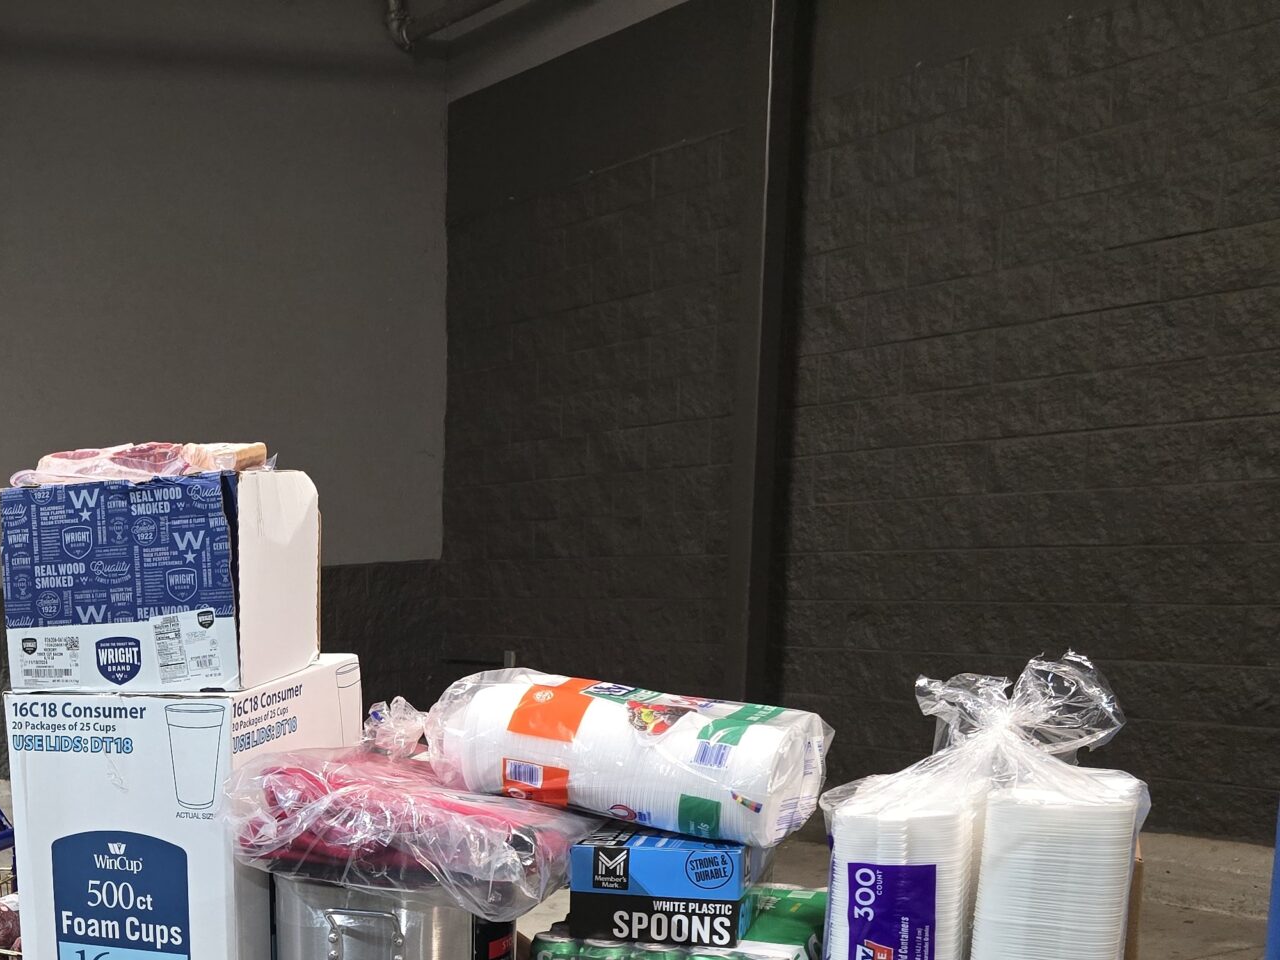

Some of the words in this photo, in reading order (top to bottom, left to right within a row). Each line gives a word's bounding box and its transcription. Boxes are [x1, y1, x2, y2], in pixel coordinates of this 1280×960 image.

[69, 488, 99, 508] W
[130, 491, 153, 503] REAL
[154, 487, 182, 500] WOOD
[131, 502, 170, 516] SMOKED
[65, 531, 89, 544] WRIGHT
[137, 532, 153, 540] 1922
[34, 565, 57, 577] REAL
[58, 562, 85, 575] WOOD
[90, 560, 131, 576] Quality
[36, 576, 73, 589] SMOKED
[168, 574, 194, 586] WRIGHT
[110, 593, 132, 602] WRIGHT
[98, 647, 139, 666] WRIGHT
[233, 696, 258, 718] 16C18
[260, 683, 302, 709] Consumer
[12, 702, 58, 718] 16C18
[62, 702, 146, 719] Consumer
[240, 715, 262, 730] Packages
[270, 710, 276, 719] 25
[277, 706, 288, 716] Cups
[12, 721, 22, 730] 20
[25, 721, 66, 732] Packages
[68, 722, 78, 730] of
[80, 723, 90, 731] 25
[93, 723, 116, 733] Cups
[233, 732, 250, 754] USE
[251, 725, 275, 748] LIDS:
[276, 716, 297, 739] DT18
[13, 734, 44, 752] USE
[46, 735, 88, 752] LIDS:
[91, 737, 133, 754] DT18
[94, 854, 143, 874] WinCup
[689, 856, 720, 871] STRONG
[721, 855, 728, 866] &
[594, 874, 627, 883] Member's
[694, 867, 729, 883] DURABLE
[853, 867, 875, 922] 300
[652, 900, 686, 913] WHITE
[688, 902, 732, 915] PLASTIC
[62, 911, 119, 939] Foam
[126, 916, 182, 949] Cups
[612, 910, 731, 946] SPOONS
[898, 916, 909, 954] Containers
